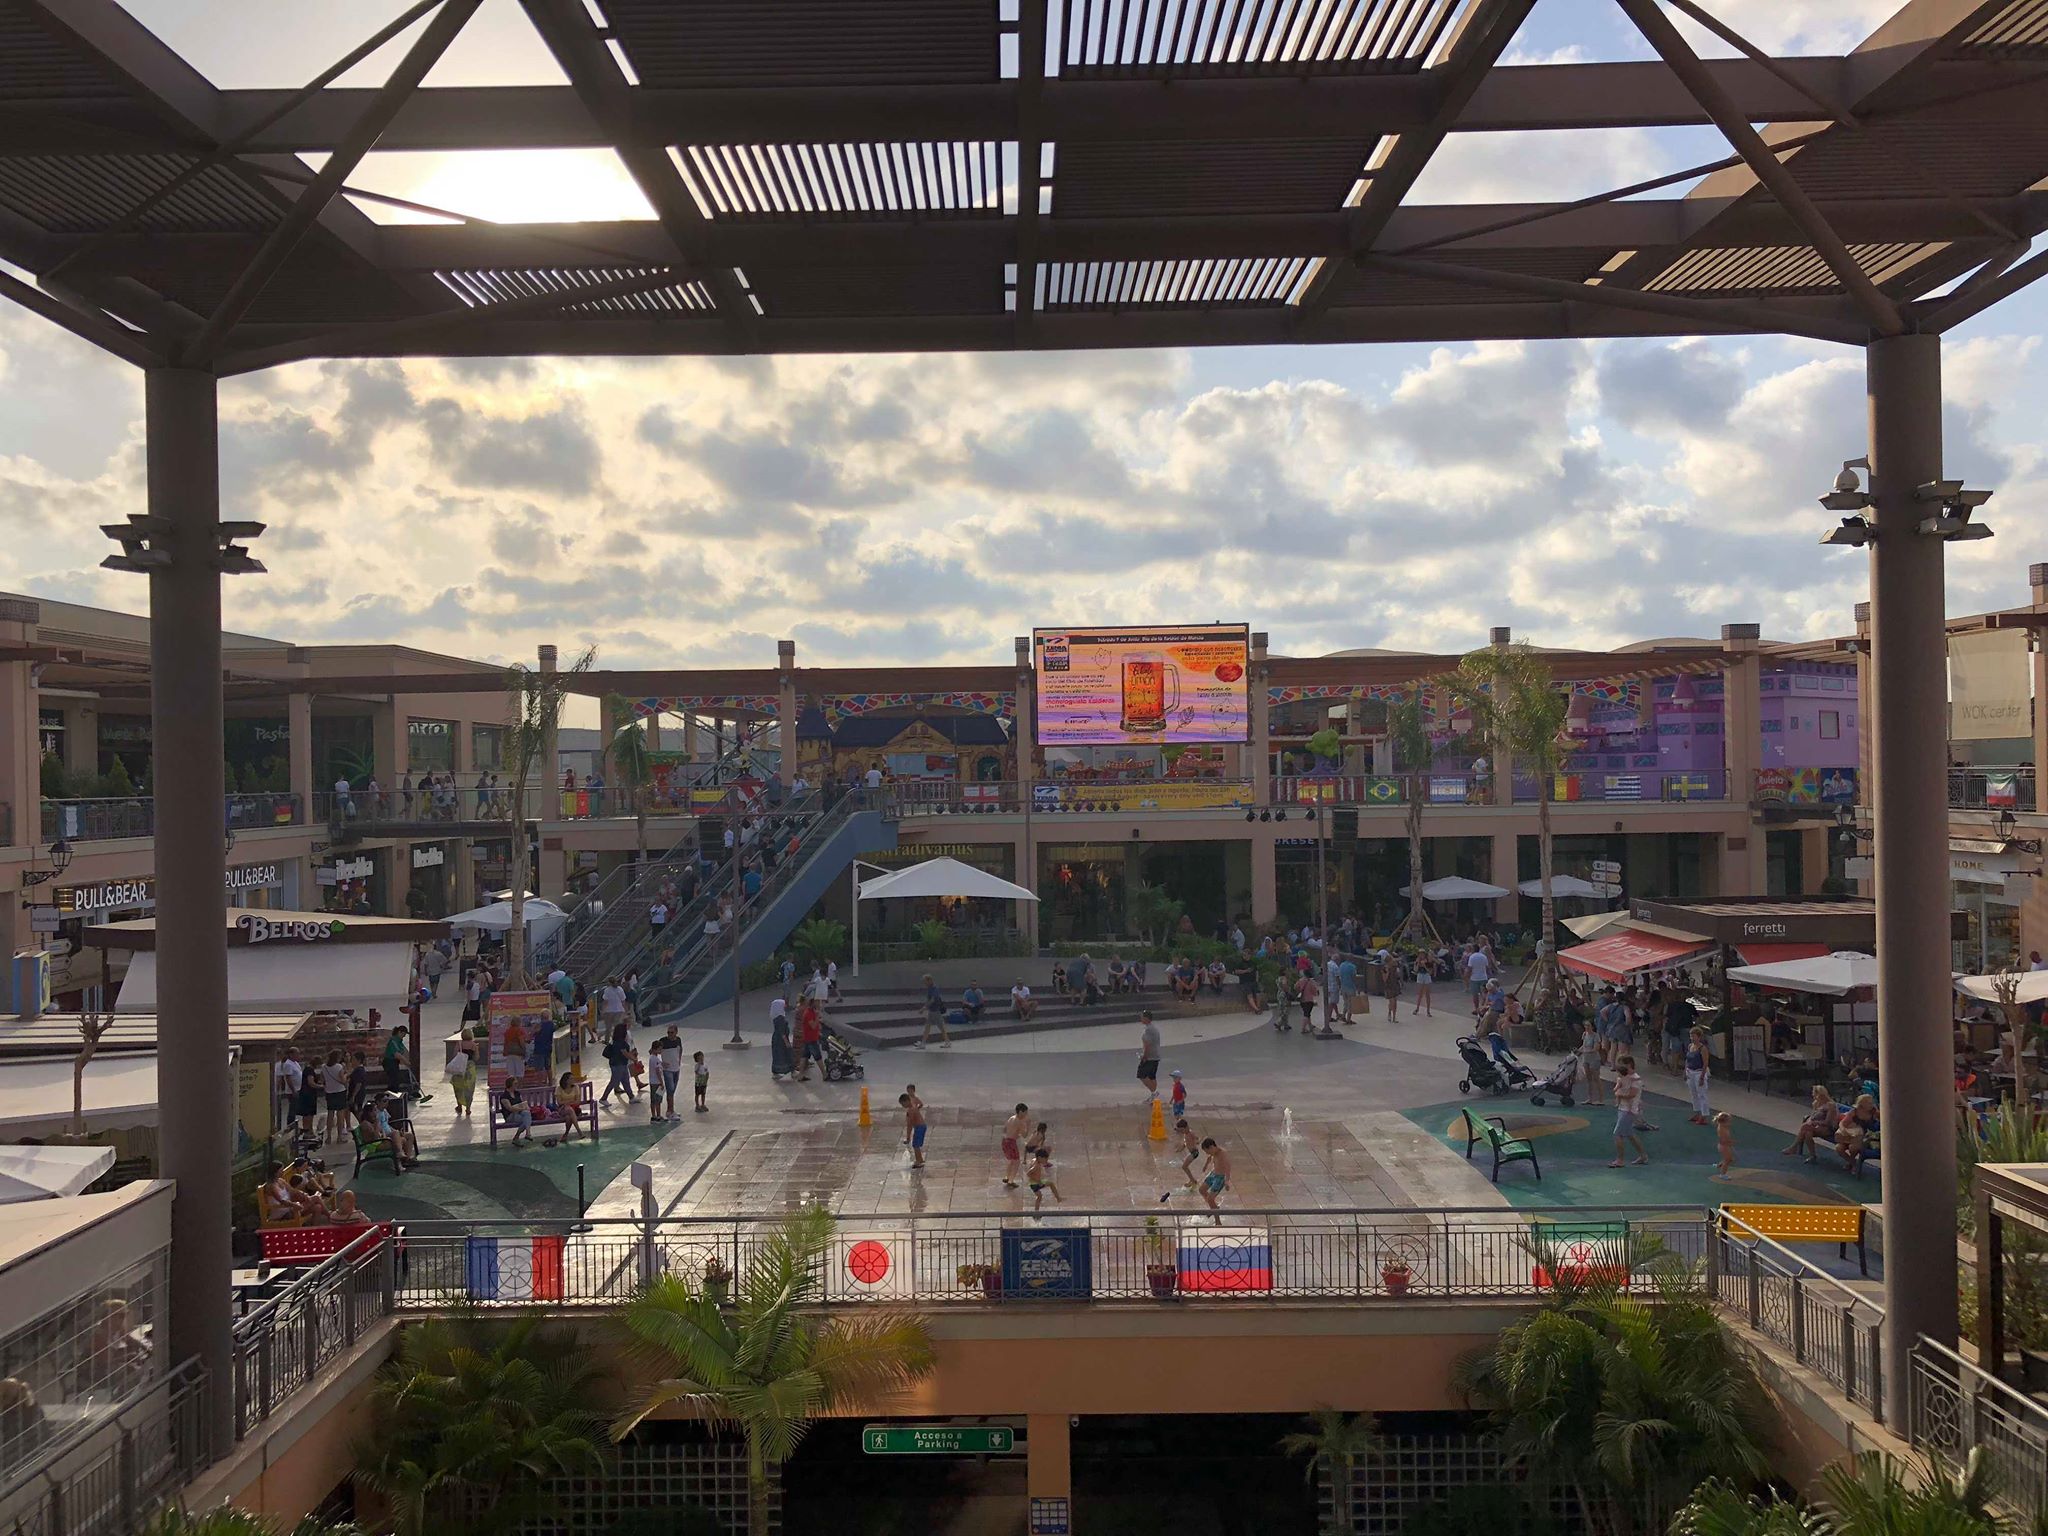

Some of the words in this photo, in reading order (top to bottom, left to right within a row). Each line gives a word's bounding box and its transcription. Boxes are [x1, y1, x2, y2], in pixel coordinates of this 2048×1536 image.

[1954, 860, 1984, 870] HOME
[226, 866, 276, 888] PULL&BEAR
[75, 882, 147, 910] PULL&BEAR
[1744, 922, 1786, 937] ferretti
[1020, 1260, 1072, 1272] ZENIA
[914, 1432, 954, 1440] Acceso
[917, 1440, 960, 1449] Parking
